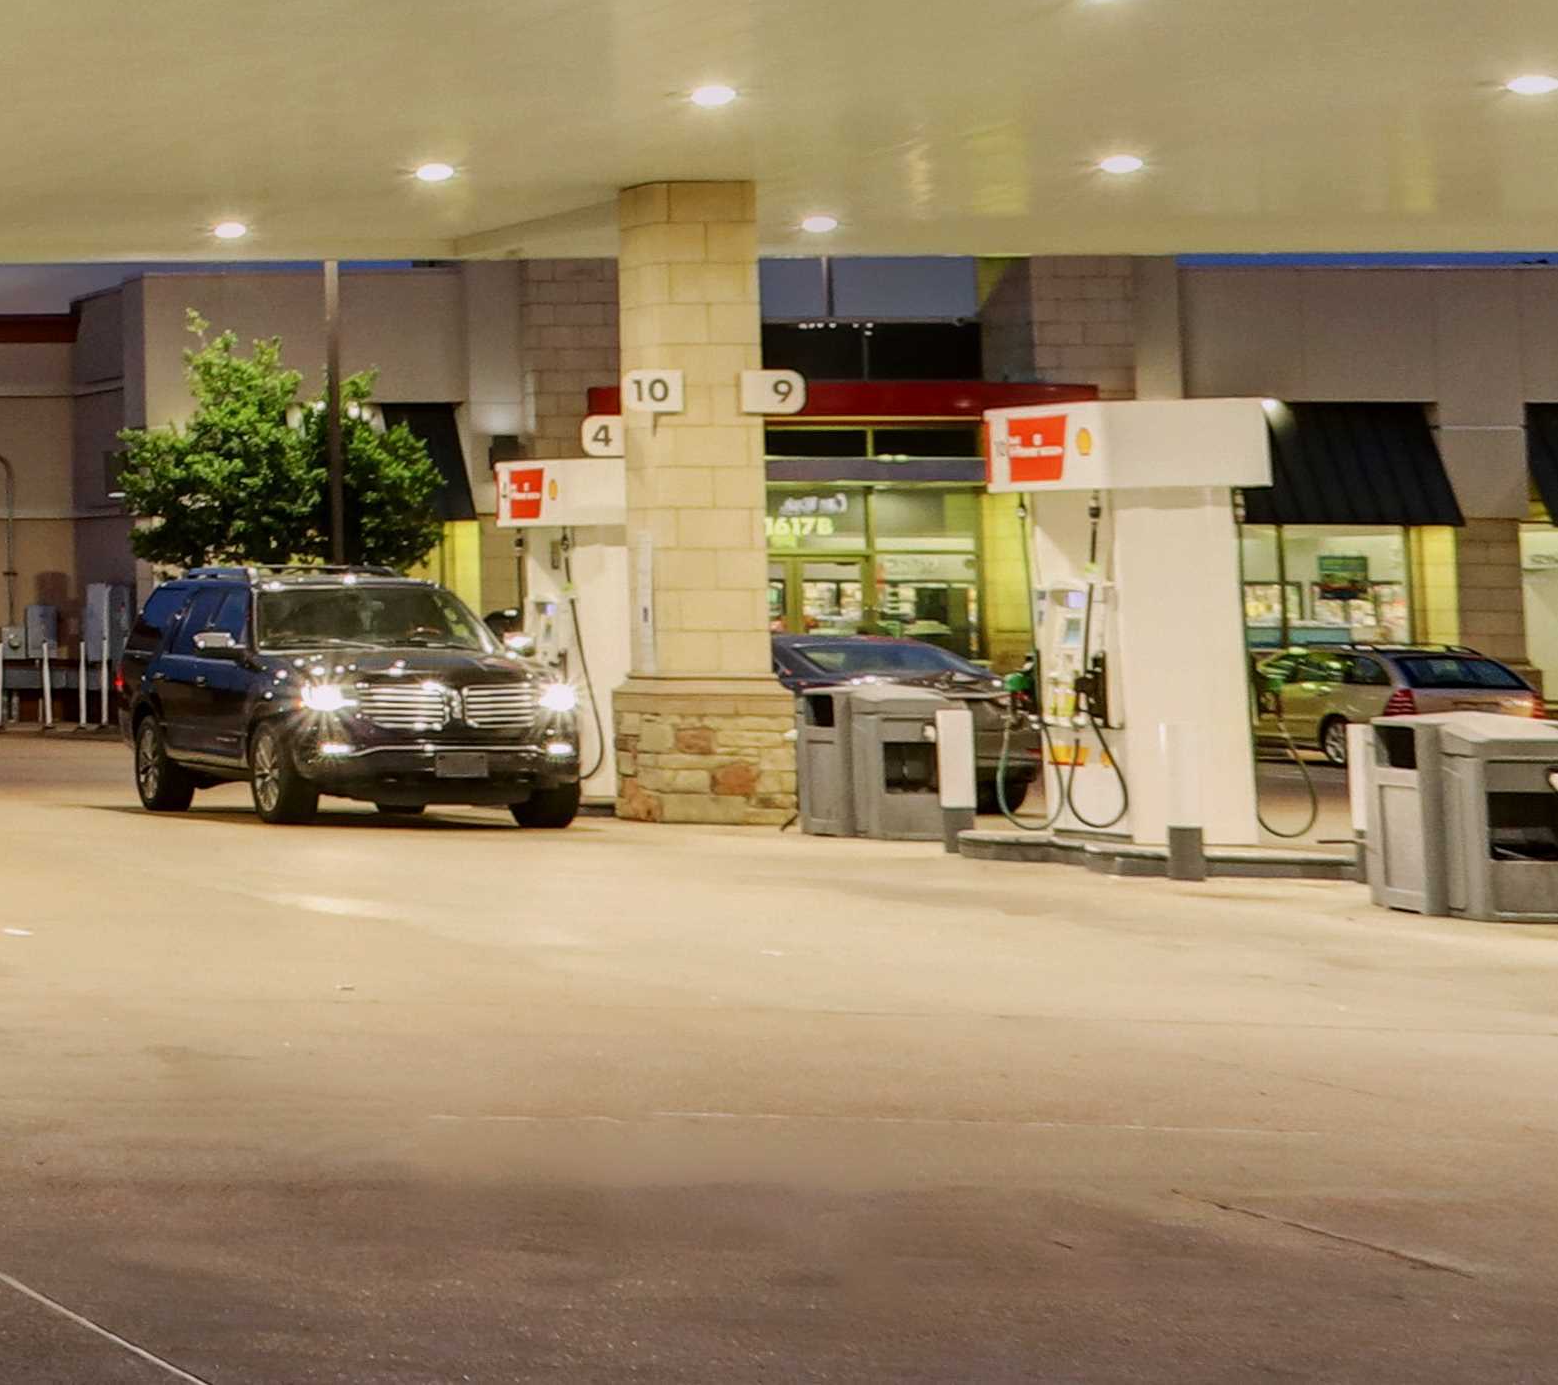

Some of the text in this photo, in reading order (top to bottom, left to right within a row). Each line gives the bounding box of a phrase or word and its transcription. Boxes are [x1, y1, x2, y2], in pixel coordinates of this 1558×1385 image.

[632, 379, 669, 402] 10
[772, 379, 793, 404] 9
[591, 424, 613, 447] 4
